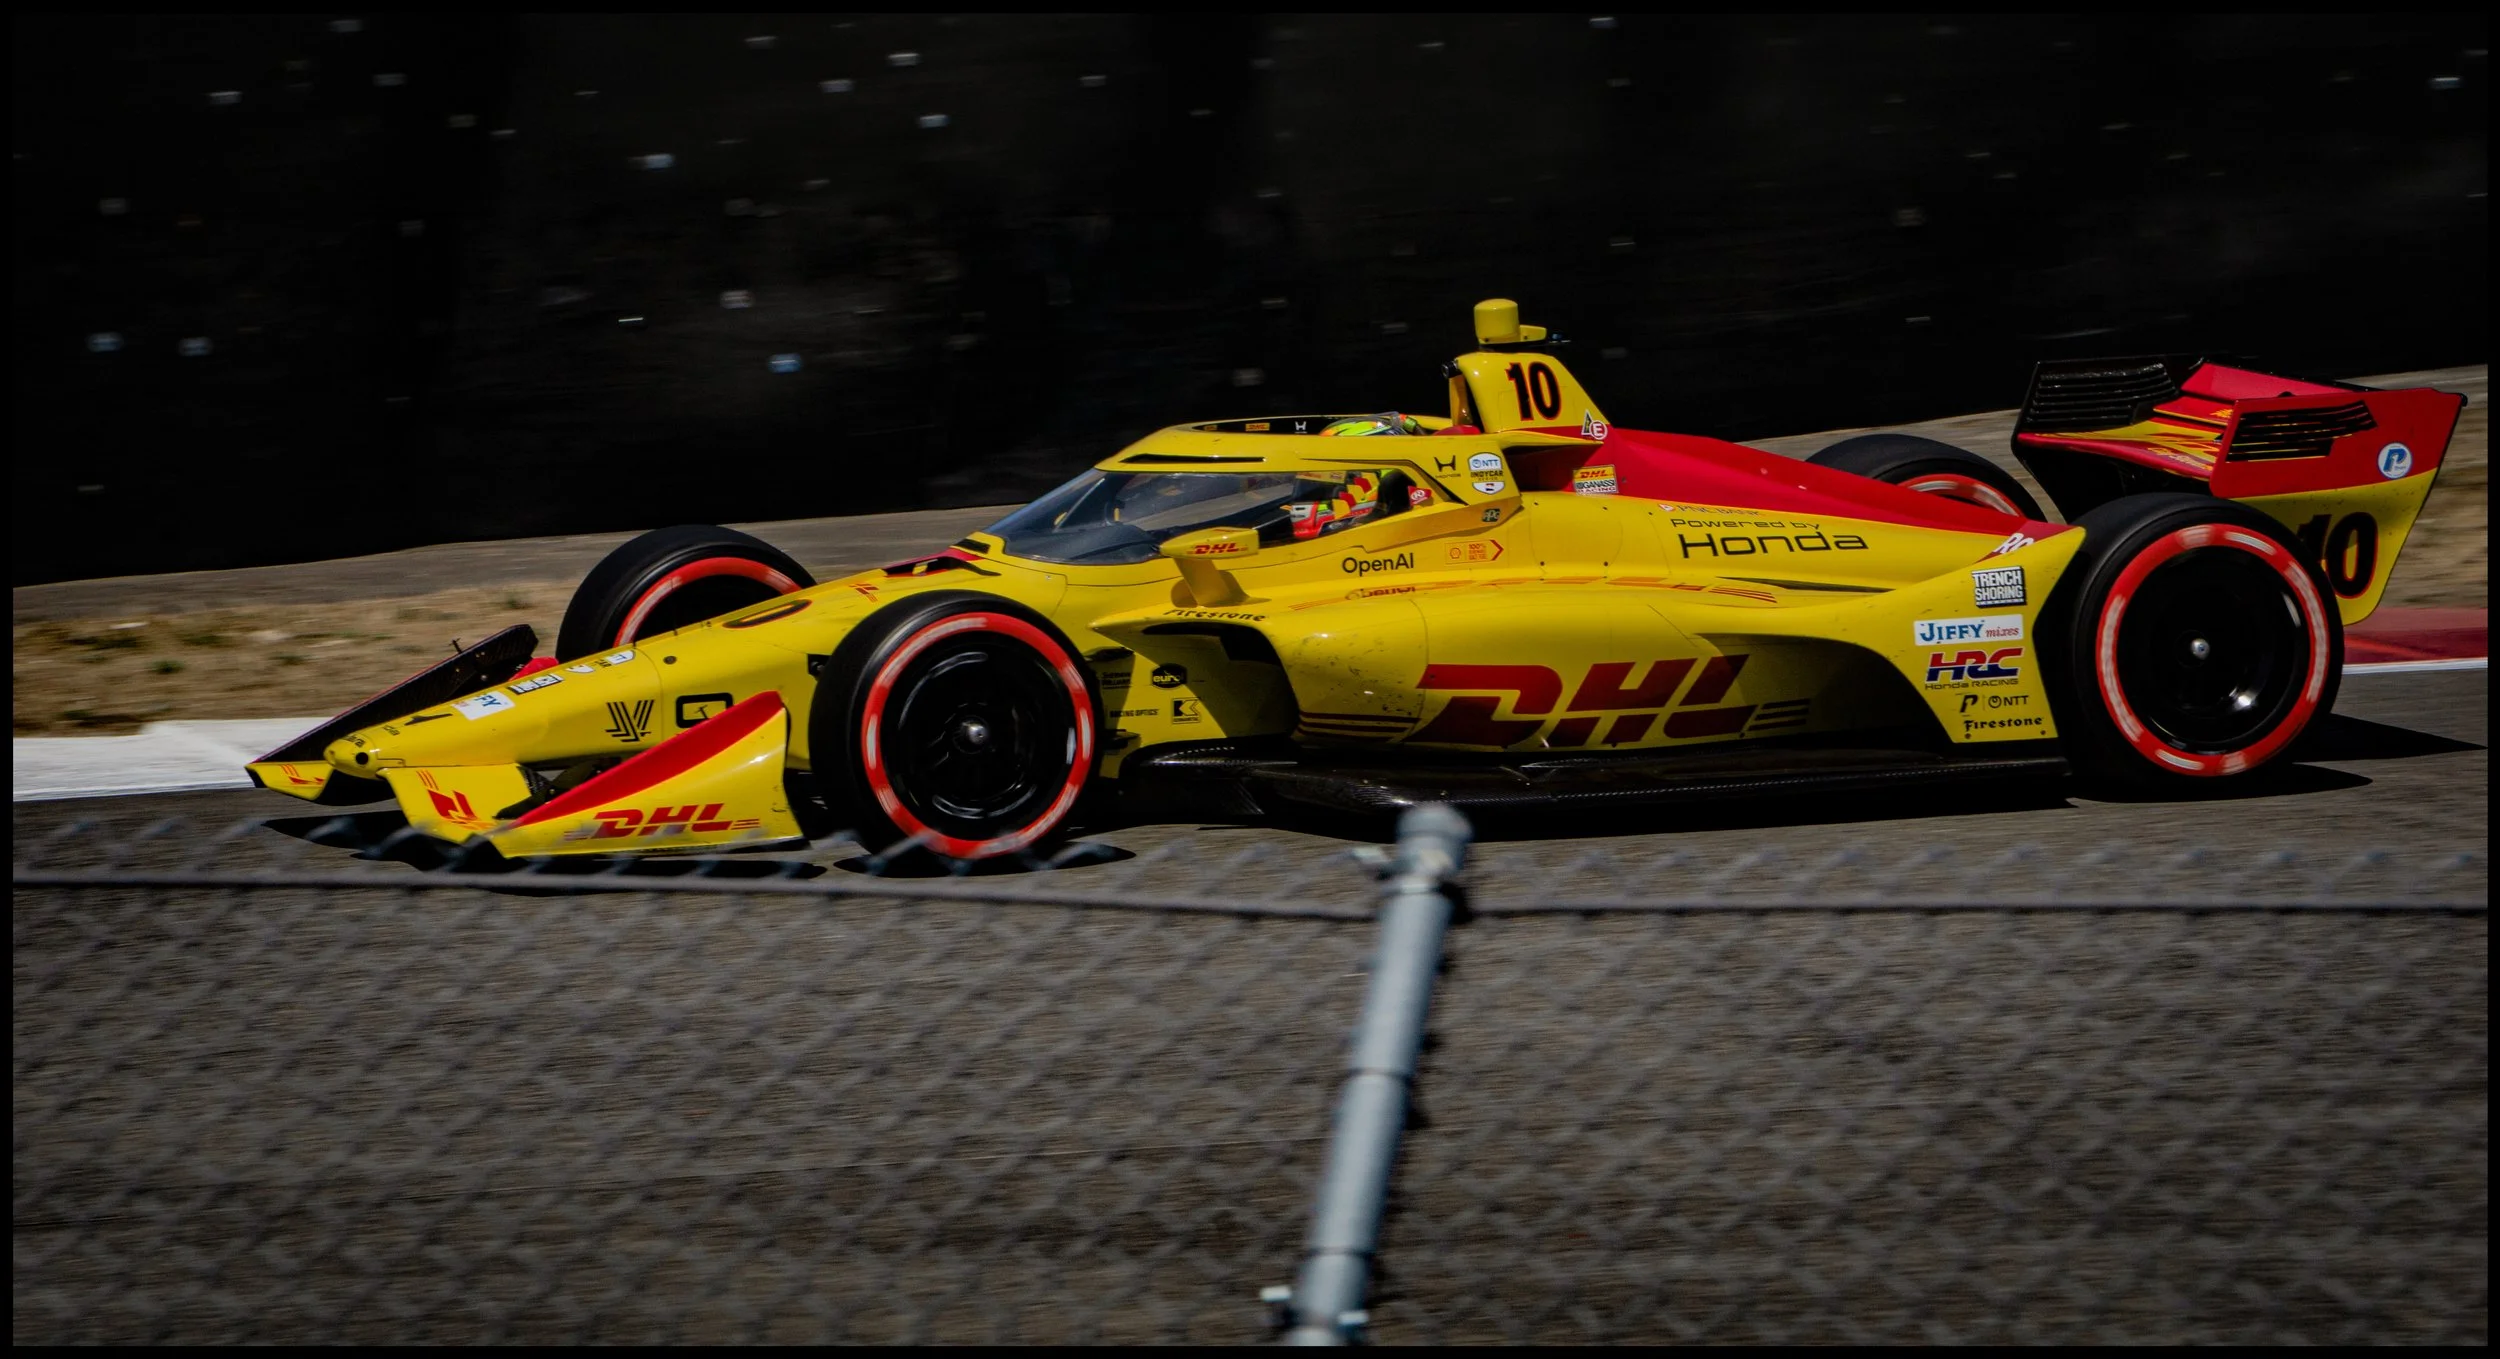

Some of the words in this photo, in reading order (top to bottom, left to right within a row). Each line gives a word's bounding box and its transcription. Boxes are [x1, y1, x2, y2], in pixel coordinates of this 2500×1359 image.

[1505, 361, 1561, 421] 10
[1482, 459, 1499, 467] NTT
[1470, 470, 1504, 478] INDYCAR
[1580, 470, 1608, 479] DHL
[1670, 518, 1785, 529] Powered
[1791, 520, 1821, 531] by
[1195, 542, 1239, 555] DHL
[1678, 531, 1869, 559] Honda
[2296, 512, 2378, 598] 10
[1342, 552, 1415, 577] OpenAI
[1973, 570, 2022, 587] TRENCH
[1975, 585, 2024, 601] SHORING
[1163, 608, 1266, 622] Firestone
[1920, 623, 1984, 642] JIFFY
[1986, 626, 2020, 638] mixes
[1926, 647, 2024, 682] HRC
[1925, 682, 1969, 691] Honda
[1971, 678, 2019, 688] RACING
[1405, 654, 1759, 748] DHL
[2004, 695, 2029, 706] NTT
[1963, 717, 2043, 731] Firestone
[592, 803, 732, 839] DHL
